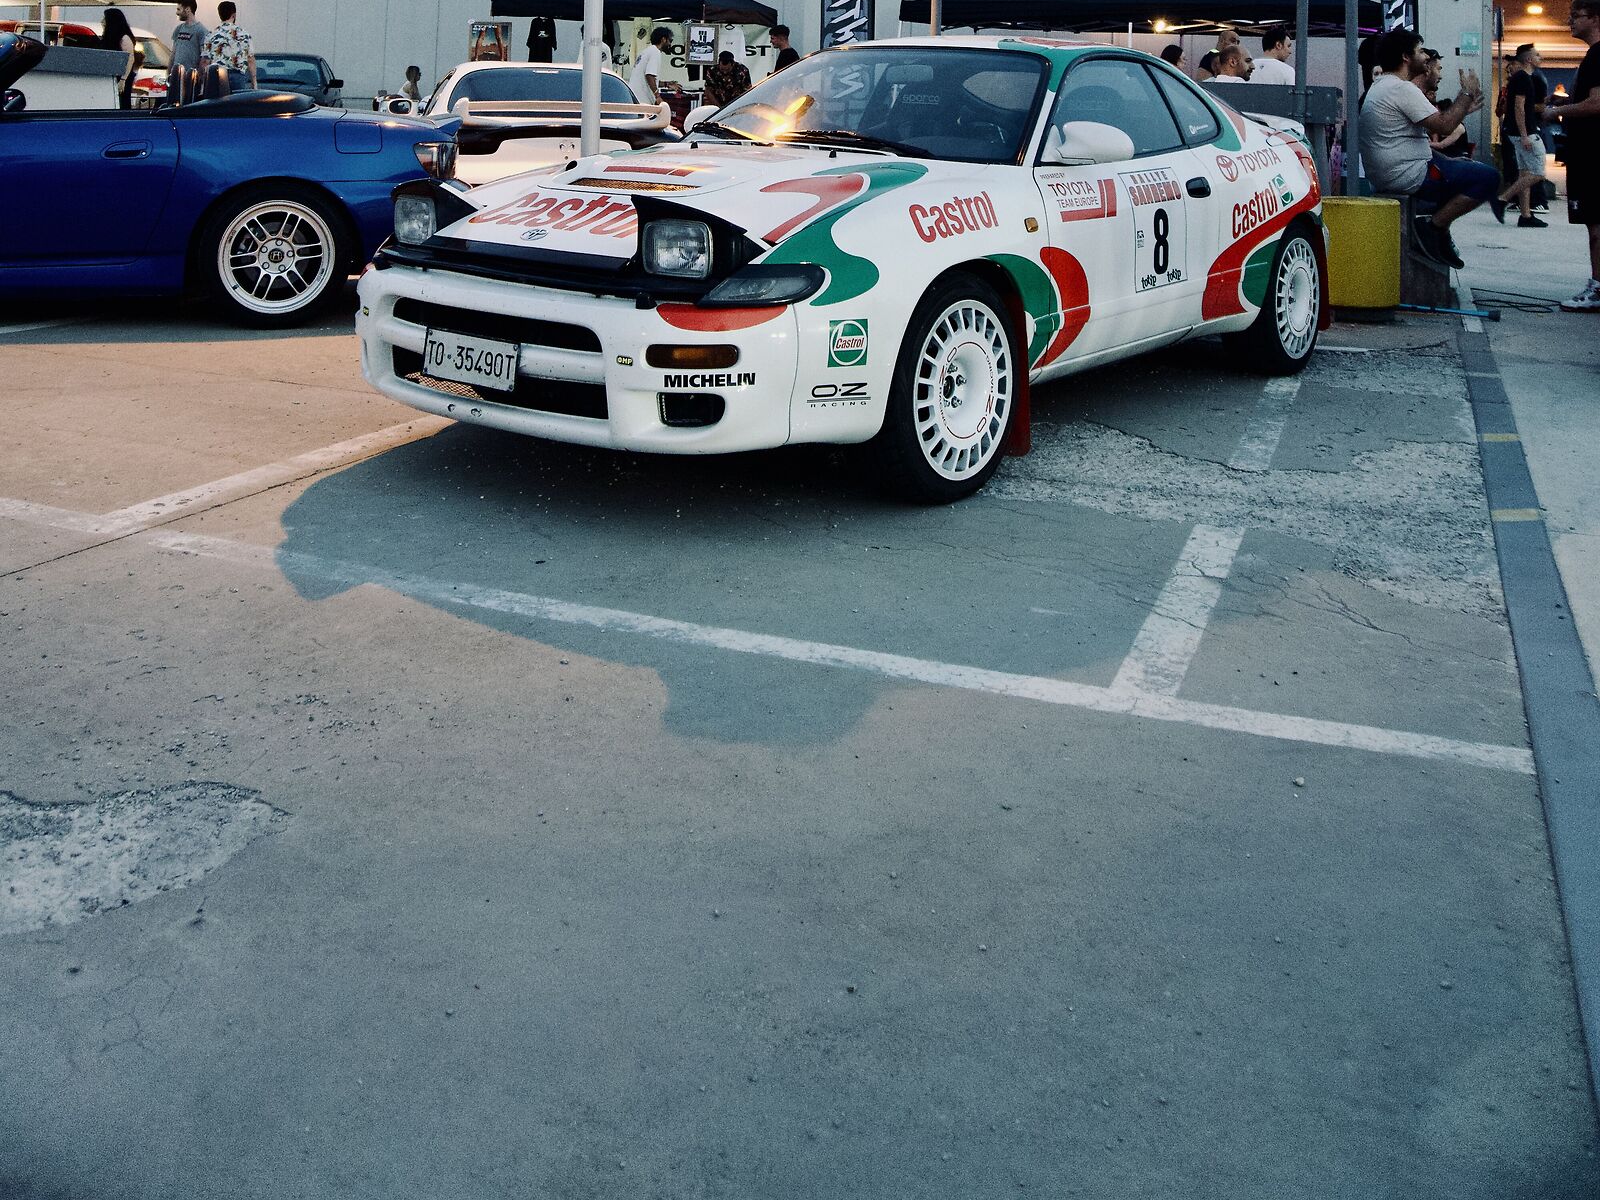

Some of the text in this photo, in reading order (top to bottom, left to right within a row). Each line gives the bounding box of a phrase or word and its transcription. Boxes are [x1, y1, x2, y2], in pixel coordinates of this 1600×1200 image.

[1235, 147, 1282, 174] TOYOTA
[1047, 180, 1096, 198] TOYOTA
[1129, 170, 1169, 185] RALLYE
[1056, 196, 1100, 209] TEAM EUROPE
[1128, 180, 1182, 207] SANREMO
[468, 192, 638, 238] Castro
[908, 191, 999, 243] Castrol
[1232, 181, 1278, 240] Castrol
[1153, 208, 1169, 275] 8
[427, 340, 445, 366] TO
[835, 337, 865, 349] Castrol
[617, 356, 633, 365] OMP
[664, 372, 756, 388] MICHELIN
